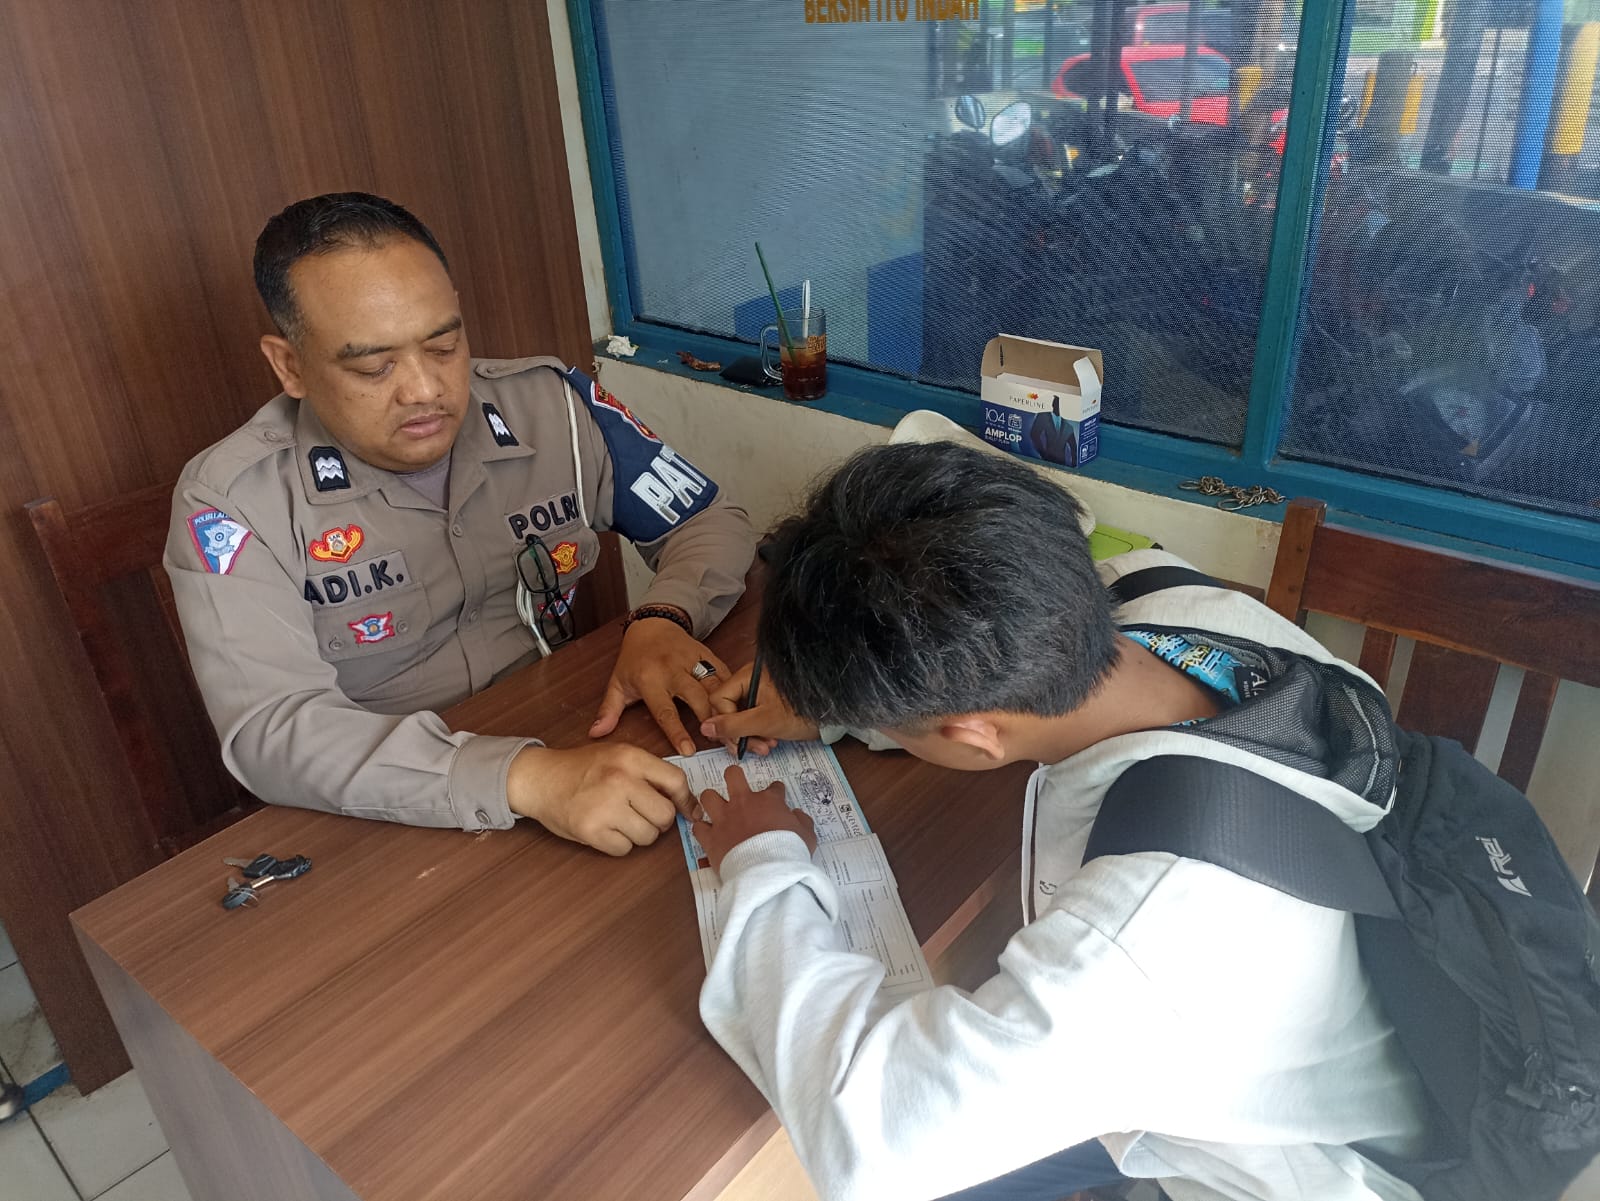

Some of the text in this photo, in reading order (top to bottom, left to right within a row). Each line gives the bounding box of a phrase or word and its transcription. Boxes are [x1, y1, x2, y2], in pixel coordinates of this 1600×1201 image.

[805, 0, 980, 23] BERSIH ITU INDAH
[1009, 395, 1045, 409] PAPERLINE
[985, 407, 1006, 424] 104
[985, 427, 1022, 442] AMPLOP
[508, 492, 579, 539] POLRI
[303, 560, 404, 605] ADI.K.
